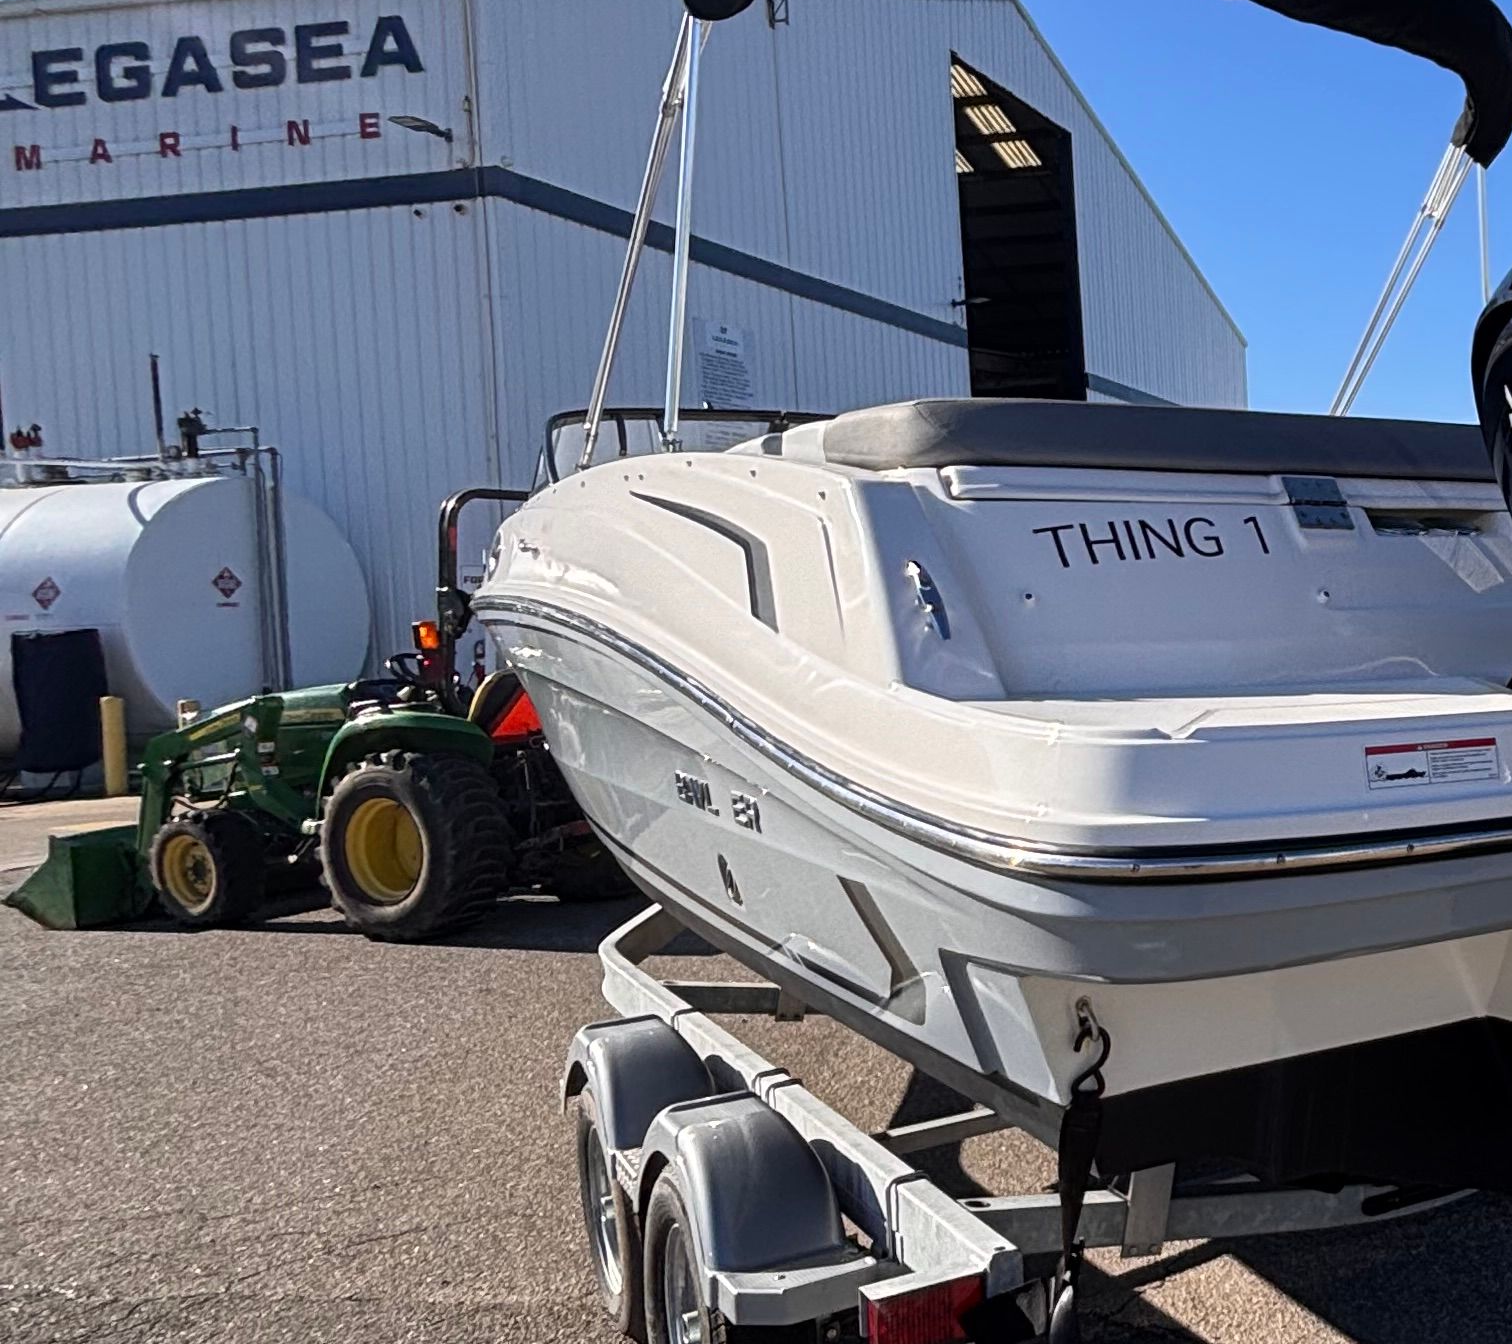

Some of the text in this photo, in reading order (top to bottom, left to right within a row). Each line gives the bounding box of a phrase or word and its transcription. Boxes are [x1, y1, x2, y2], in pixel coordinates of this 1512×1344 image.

[15, 112, 381, 171] MARINE
[1032, 516, 1270, 568] THING 1
